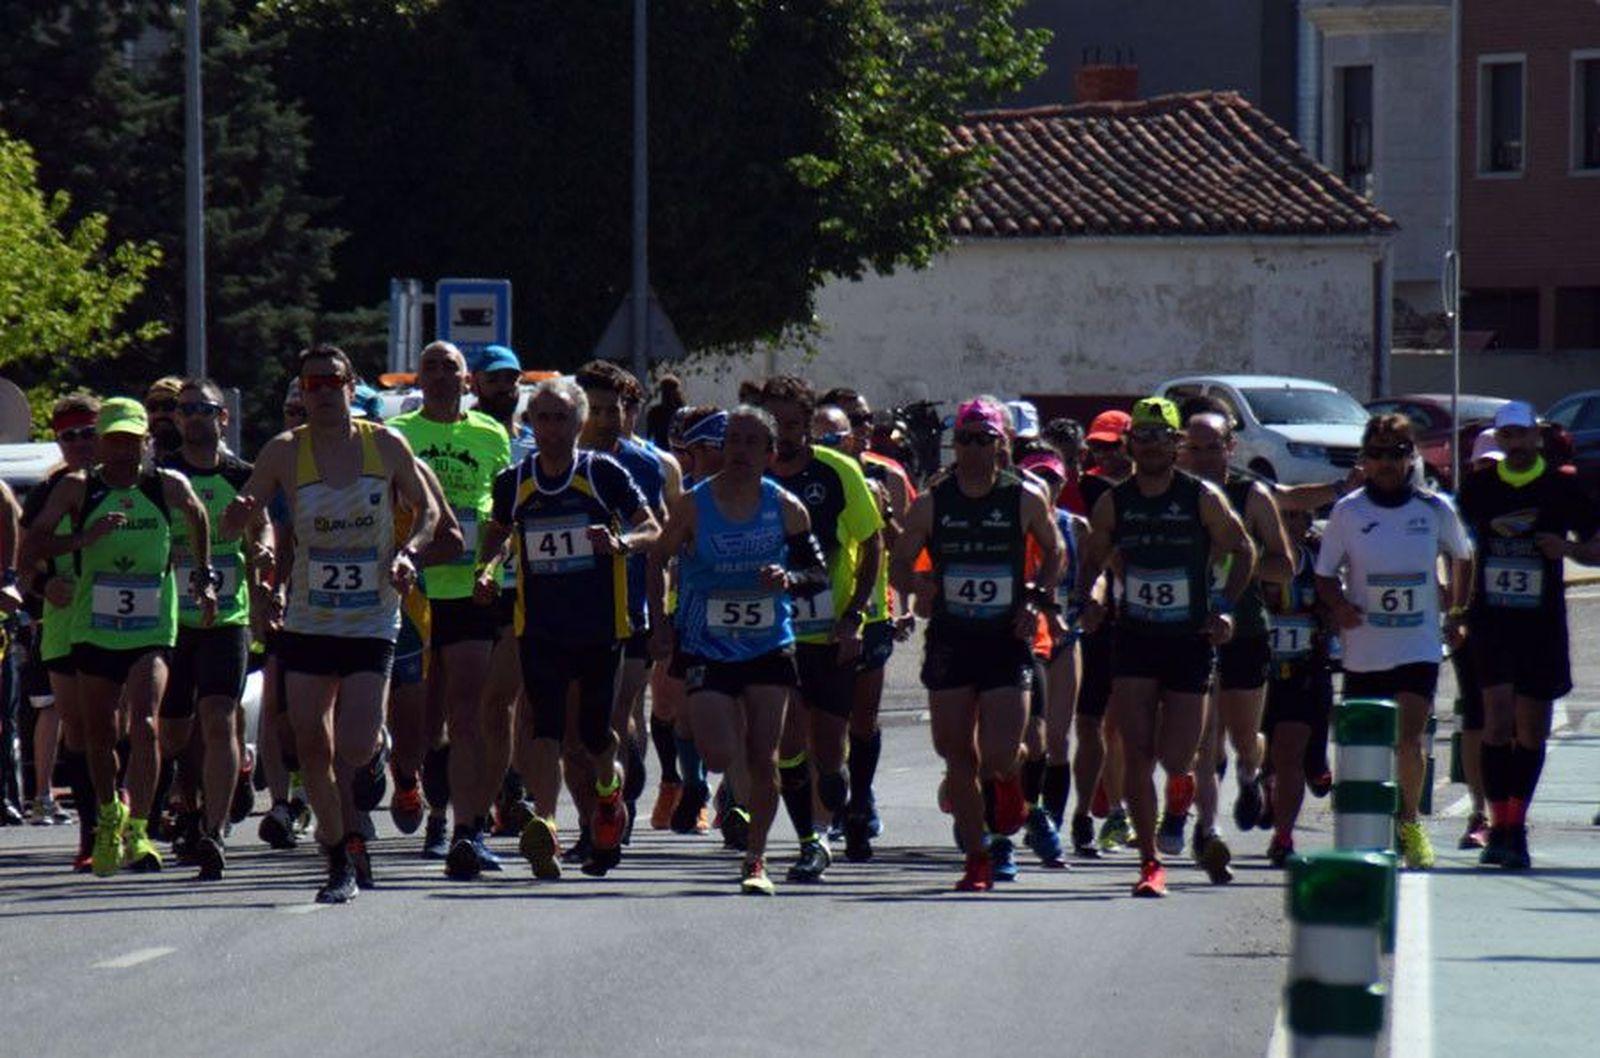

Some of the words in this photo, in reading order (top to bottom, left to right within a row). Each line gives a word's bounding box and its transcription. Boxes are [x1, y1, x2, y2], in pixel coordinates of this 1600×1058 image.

[540, 532, 572, 556] 41
[322, 565, 362, 590] 23
[1497, 571, 1527, 592] 43
[118, 590, 134, 615] 3
[958, 580, 998, 603] 49
[1138, 583, 1174, 606] 48
[1381, 589, 1414, 612] 61
[722, 602, 771, 626] 55
